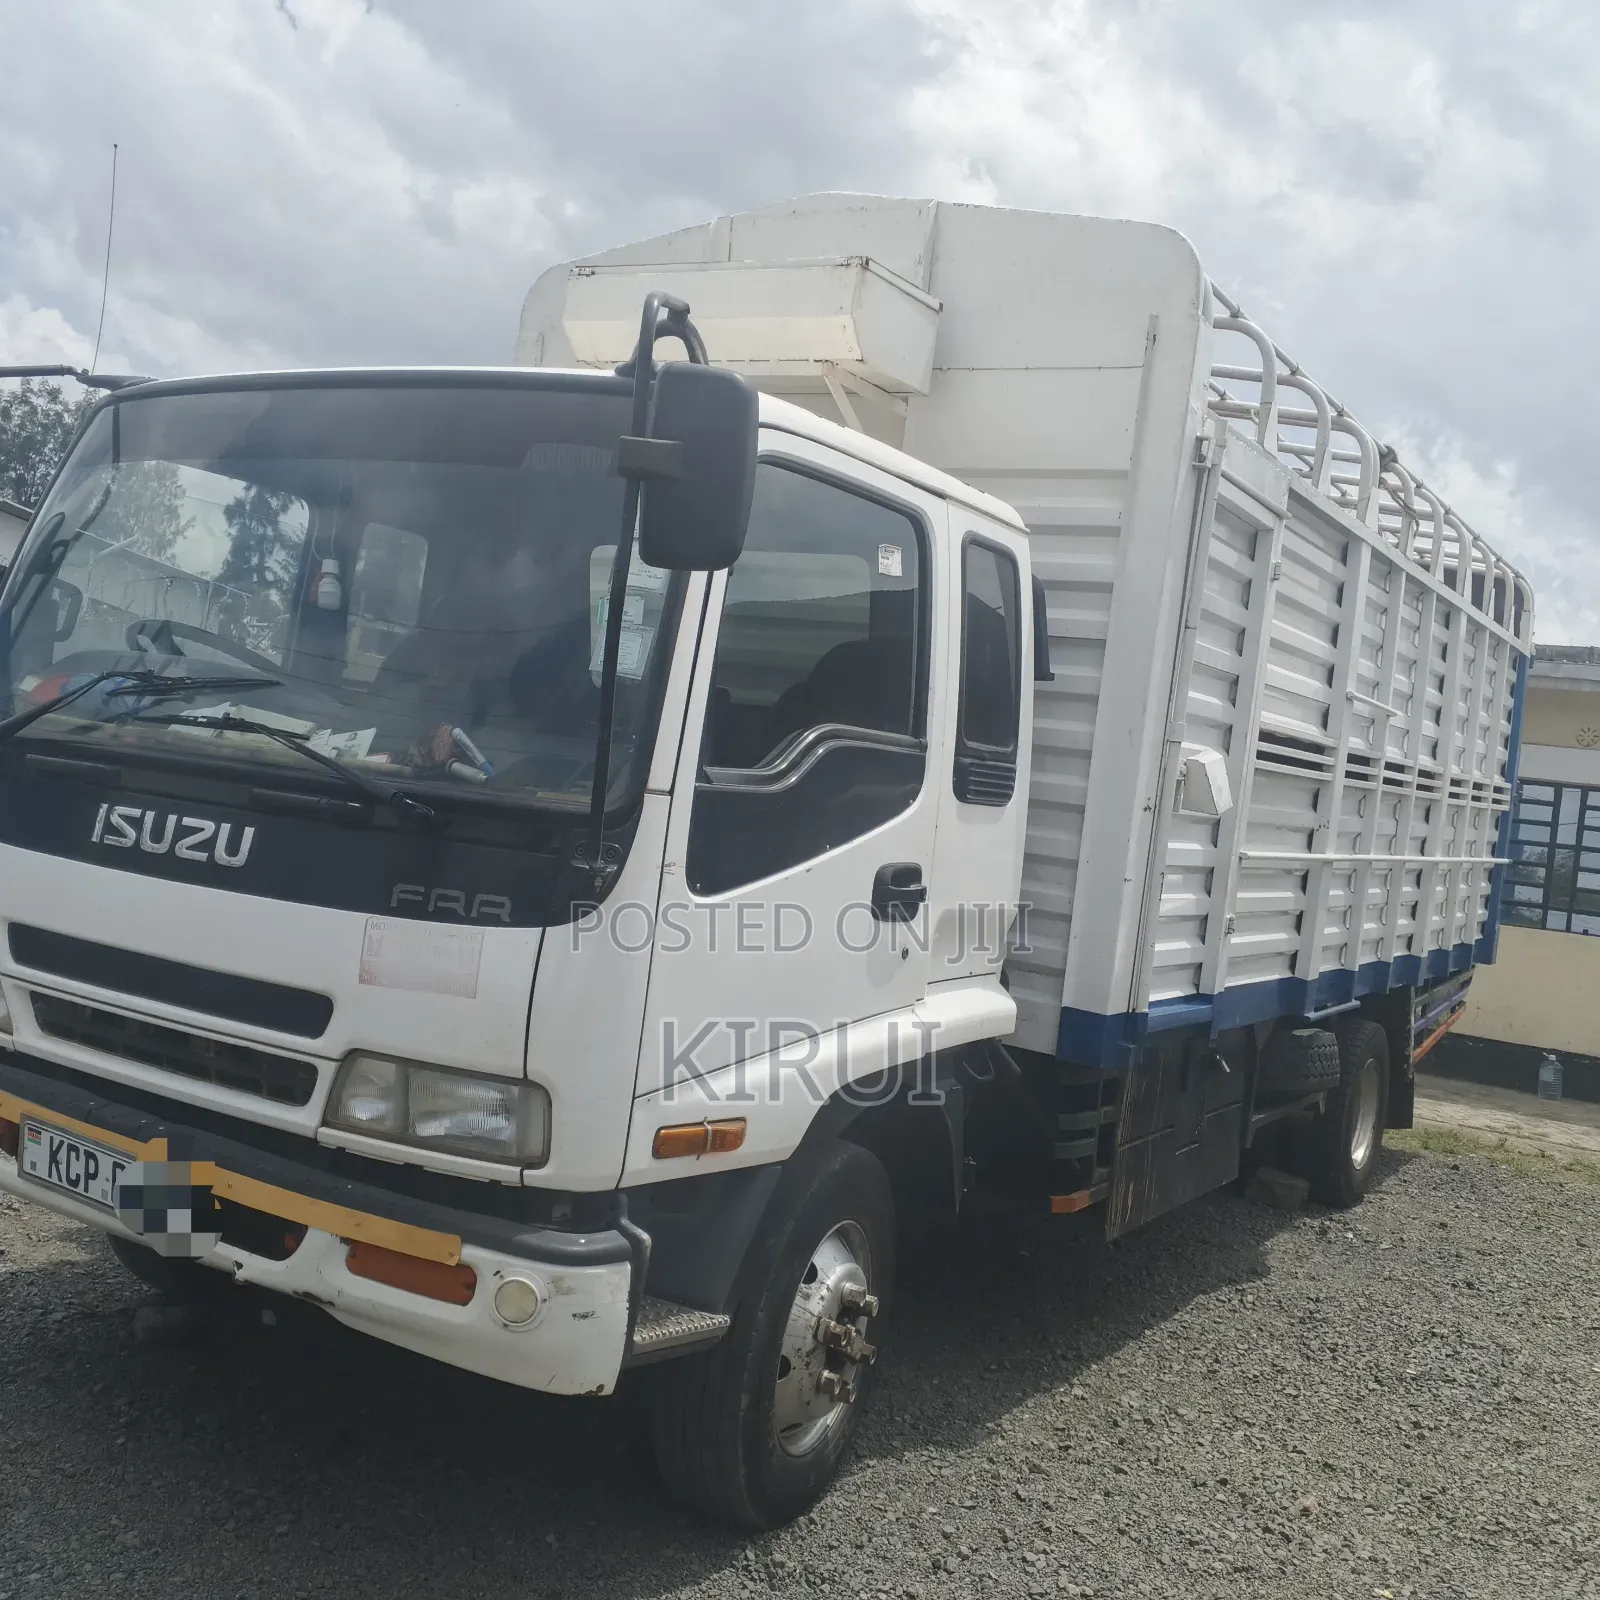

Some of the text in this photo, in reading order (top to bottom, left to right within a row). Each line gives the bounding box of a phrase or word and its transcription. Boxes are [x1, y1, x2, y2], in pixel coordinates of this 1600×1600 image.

[91, 803, 255, 867] ISUZU
[390, 883, 512, 922] FRR
[48, 1136, 99, 1193] KCP
